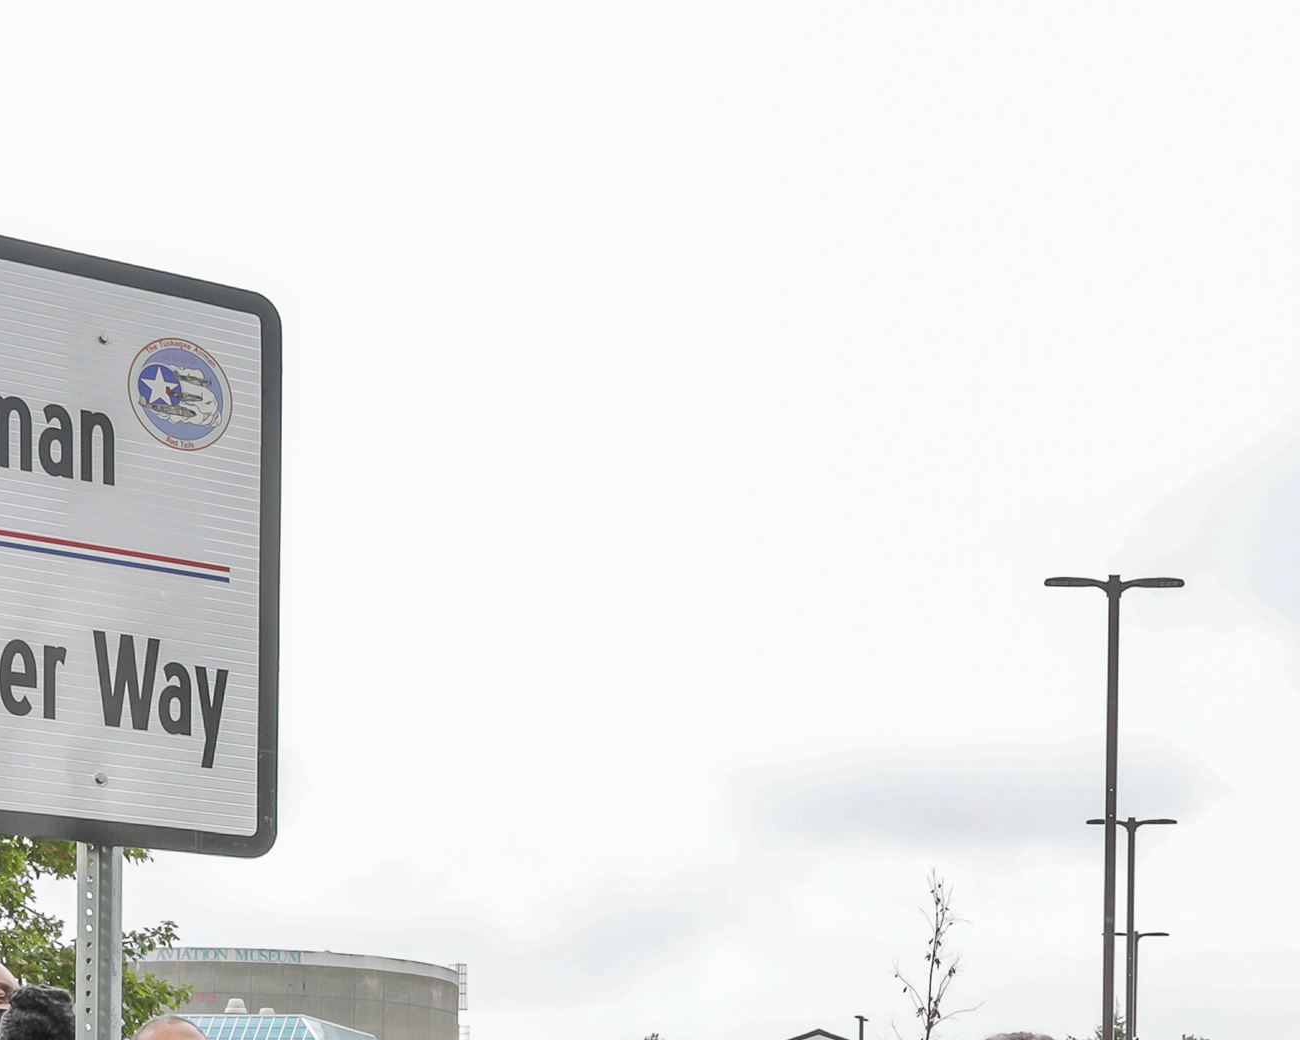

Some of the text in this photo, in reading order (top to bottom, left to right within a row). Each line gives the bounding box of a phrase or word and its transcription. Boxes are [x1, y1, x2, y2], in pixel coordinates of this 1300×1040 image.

[92, 629, 229, 769] Way
[156, 949, 301, 964] AVIATION MUSEUM
